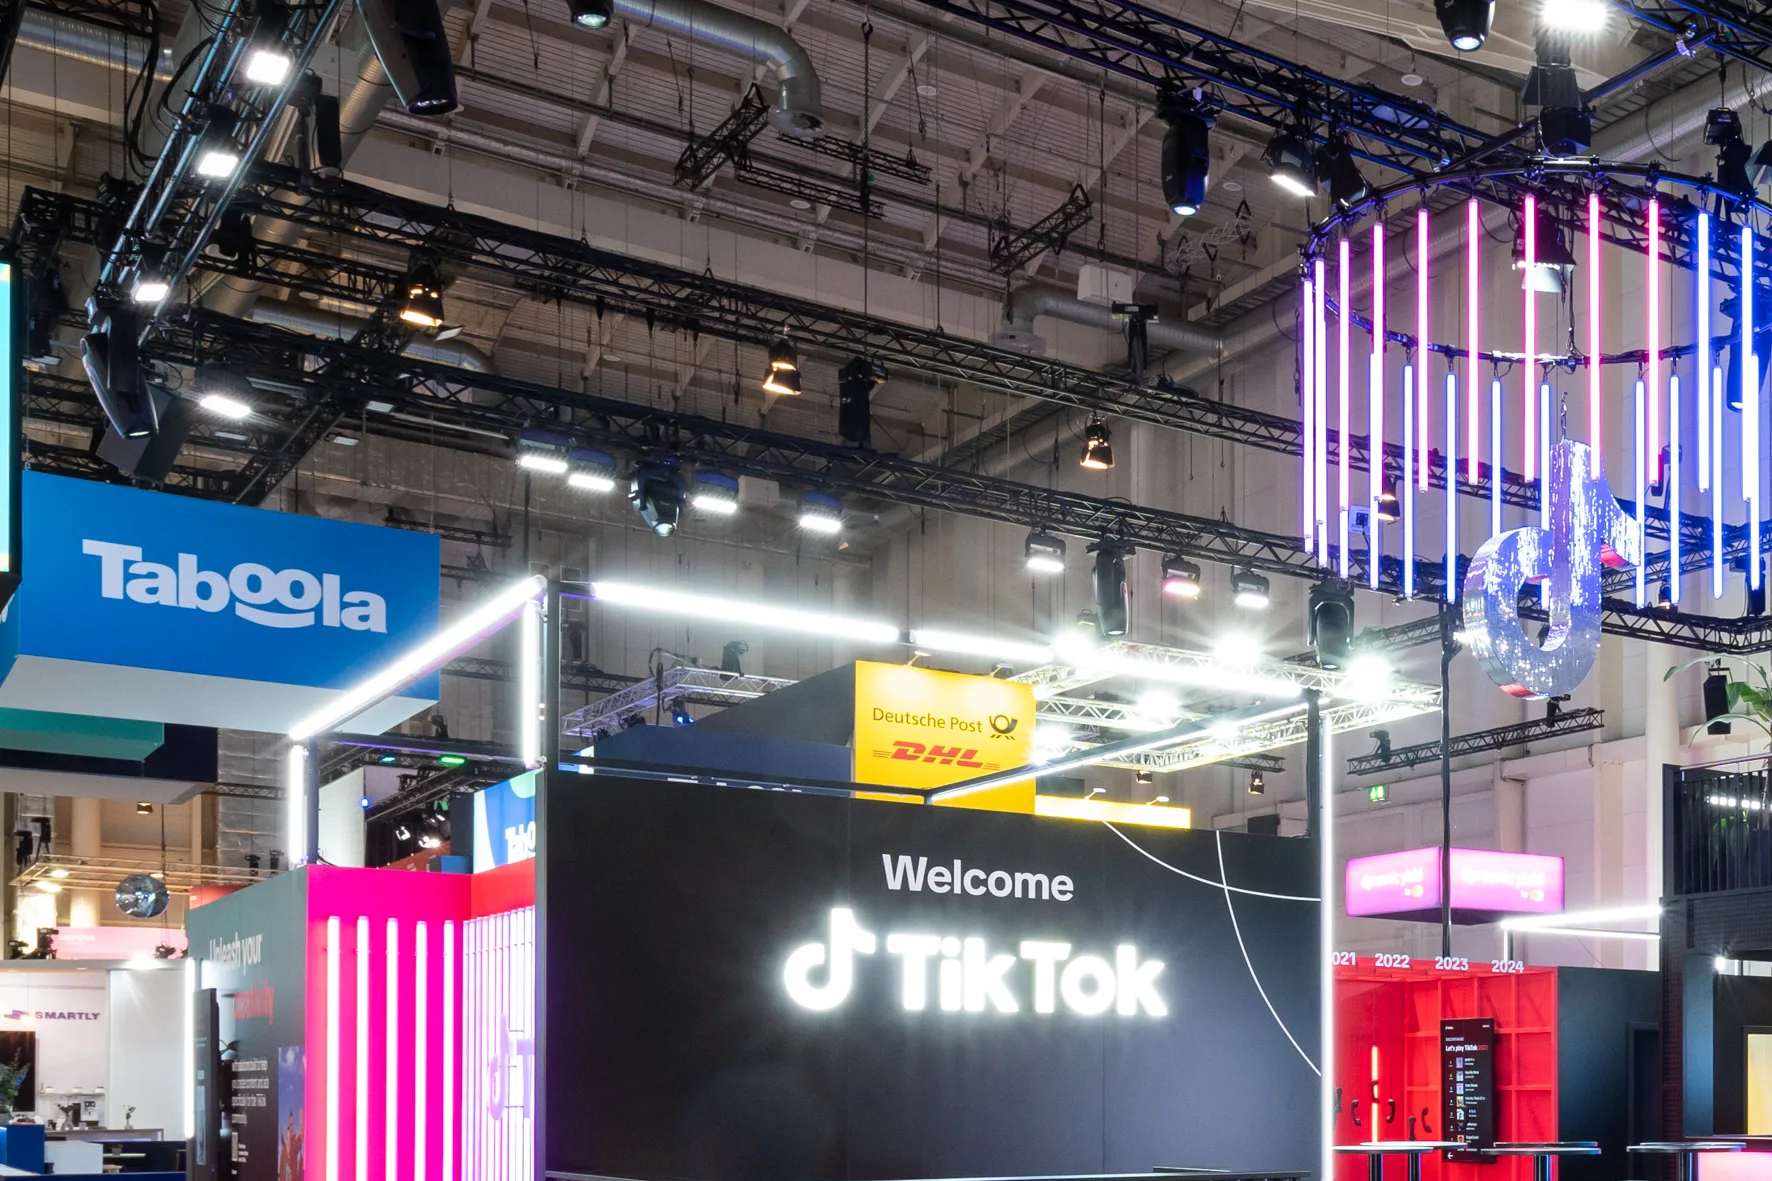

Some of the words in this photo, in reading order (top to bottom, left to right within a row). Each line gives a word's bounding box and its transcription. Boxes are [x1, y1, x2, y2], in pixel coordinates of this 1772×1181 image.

[82, 539, 387, 634] Taboola
[873, 708, 946, 729] Deutsche
[951, 717, 983, 733] Post
[891, 740, 983, 769] DHL
[882, 853, 1074, 902] Welcome
[209, 932, 241, 968] Unleash
[241, 934, 263, 976] your
[1331, 952, 1356, 966] 021
[1375, 953, 1410, 969] 2022
[1435, 956, 1469, 971] 2023
[886, 933, 1169, 1017] TikTok
[1491, 960, 1524, 974] 2024
[35, 1011, 101, 1020] SMARTLY
